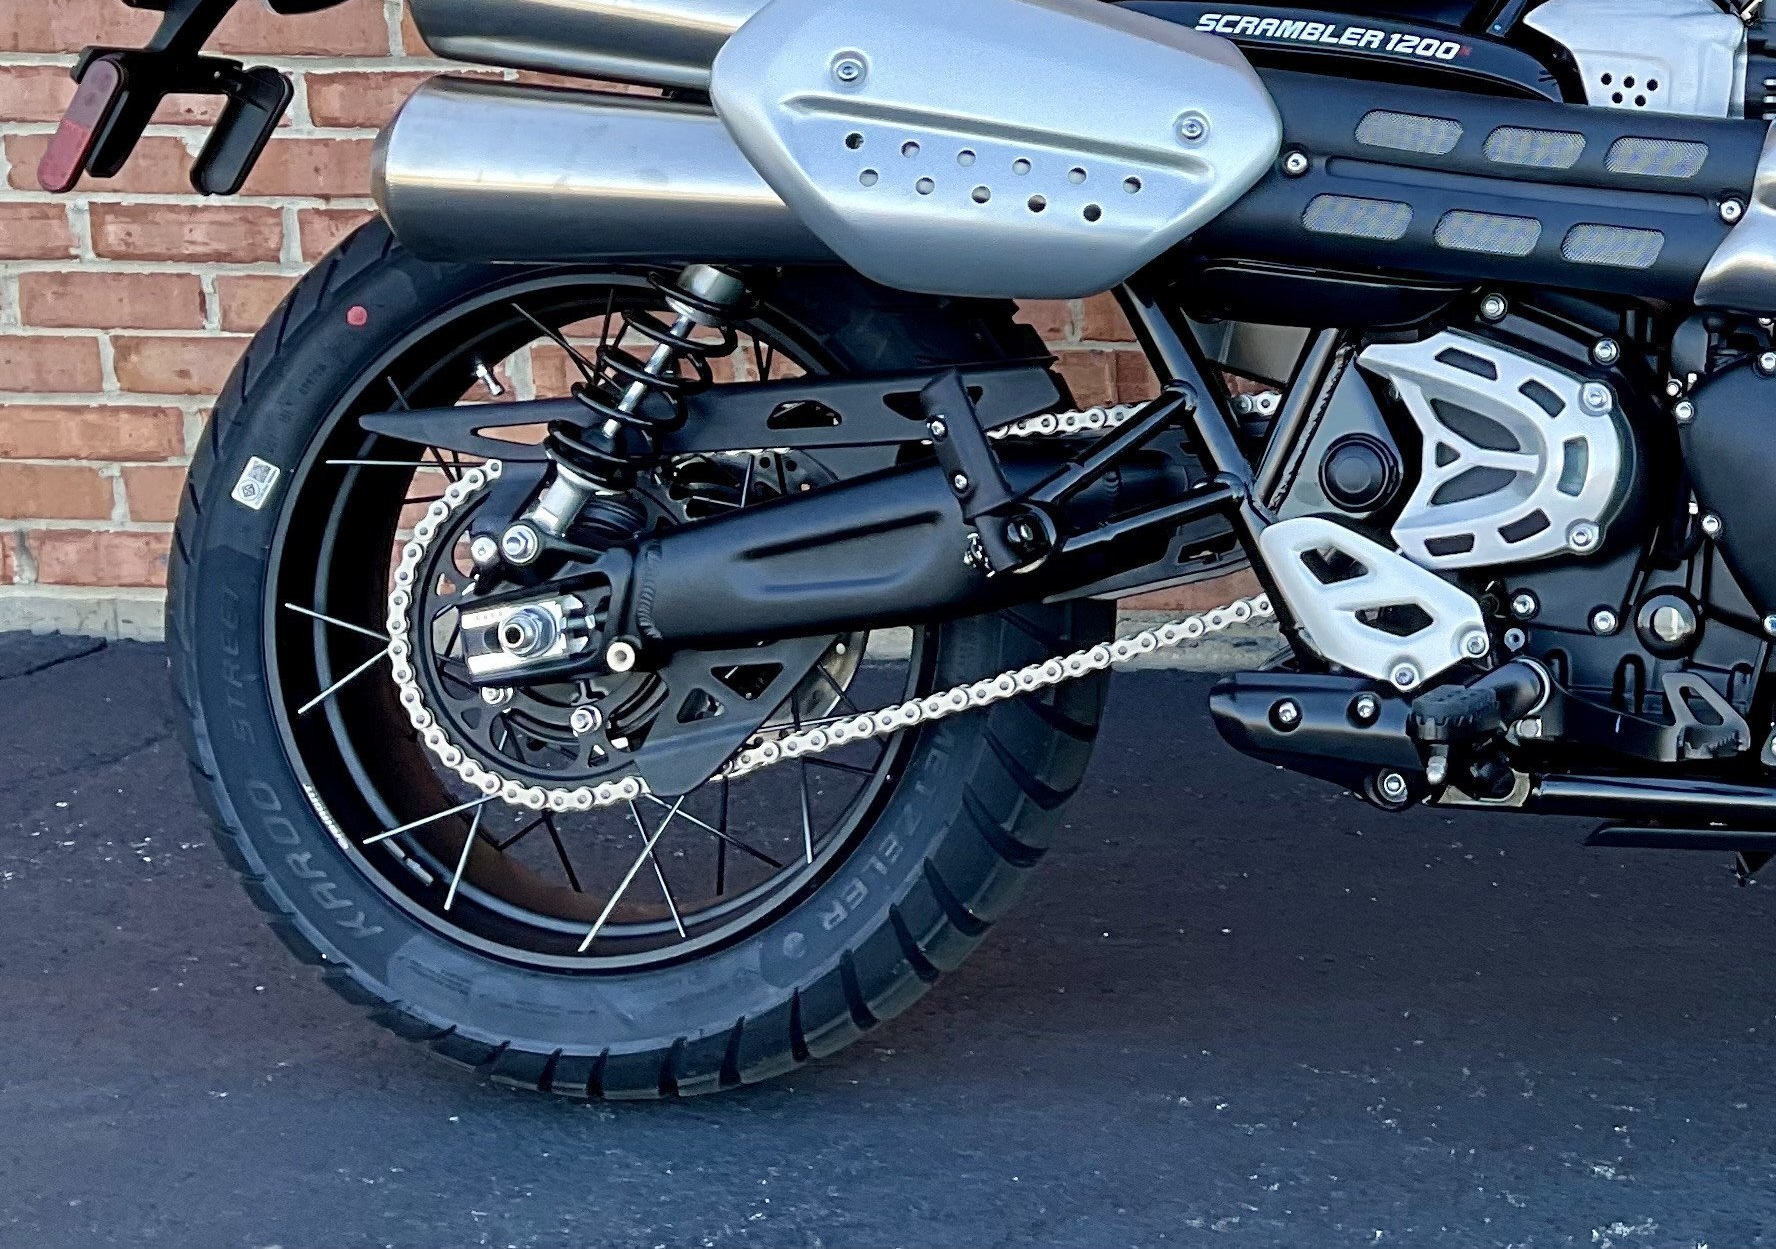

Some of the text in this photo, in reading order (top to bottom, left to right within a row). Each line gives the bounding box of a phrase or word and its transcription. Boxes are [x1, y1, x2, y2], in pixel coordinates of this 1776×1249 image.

[1195, 13, 1386, 49] SCRAMBLER
[1385, 32, 1460, 60] 1200
[248, 779, 386, 940] KAROO
